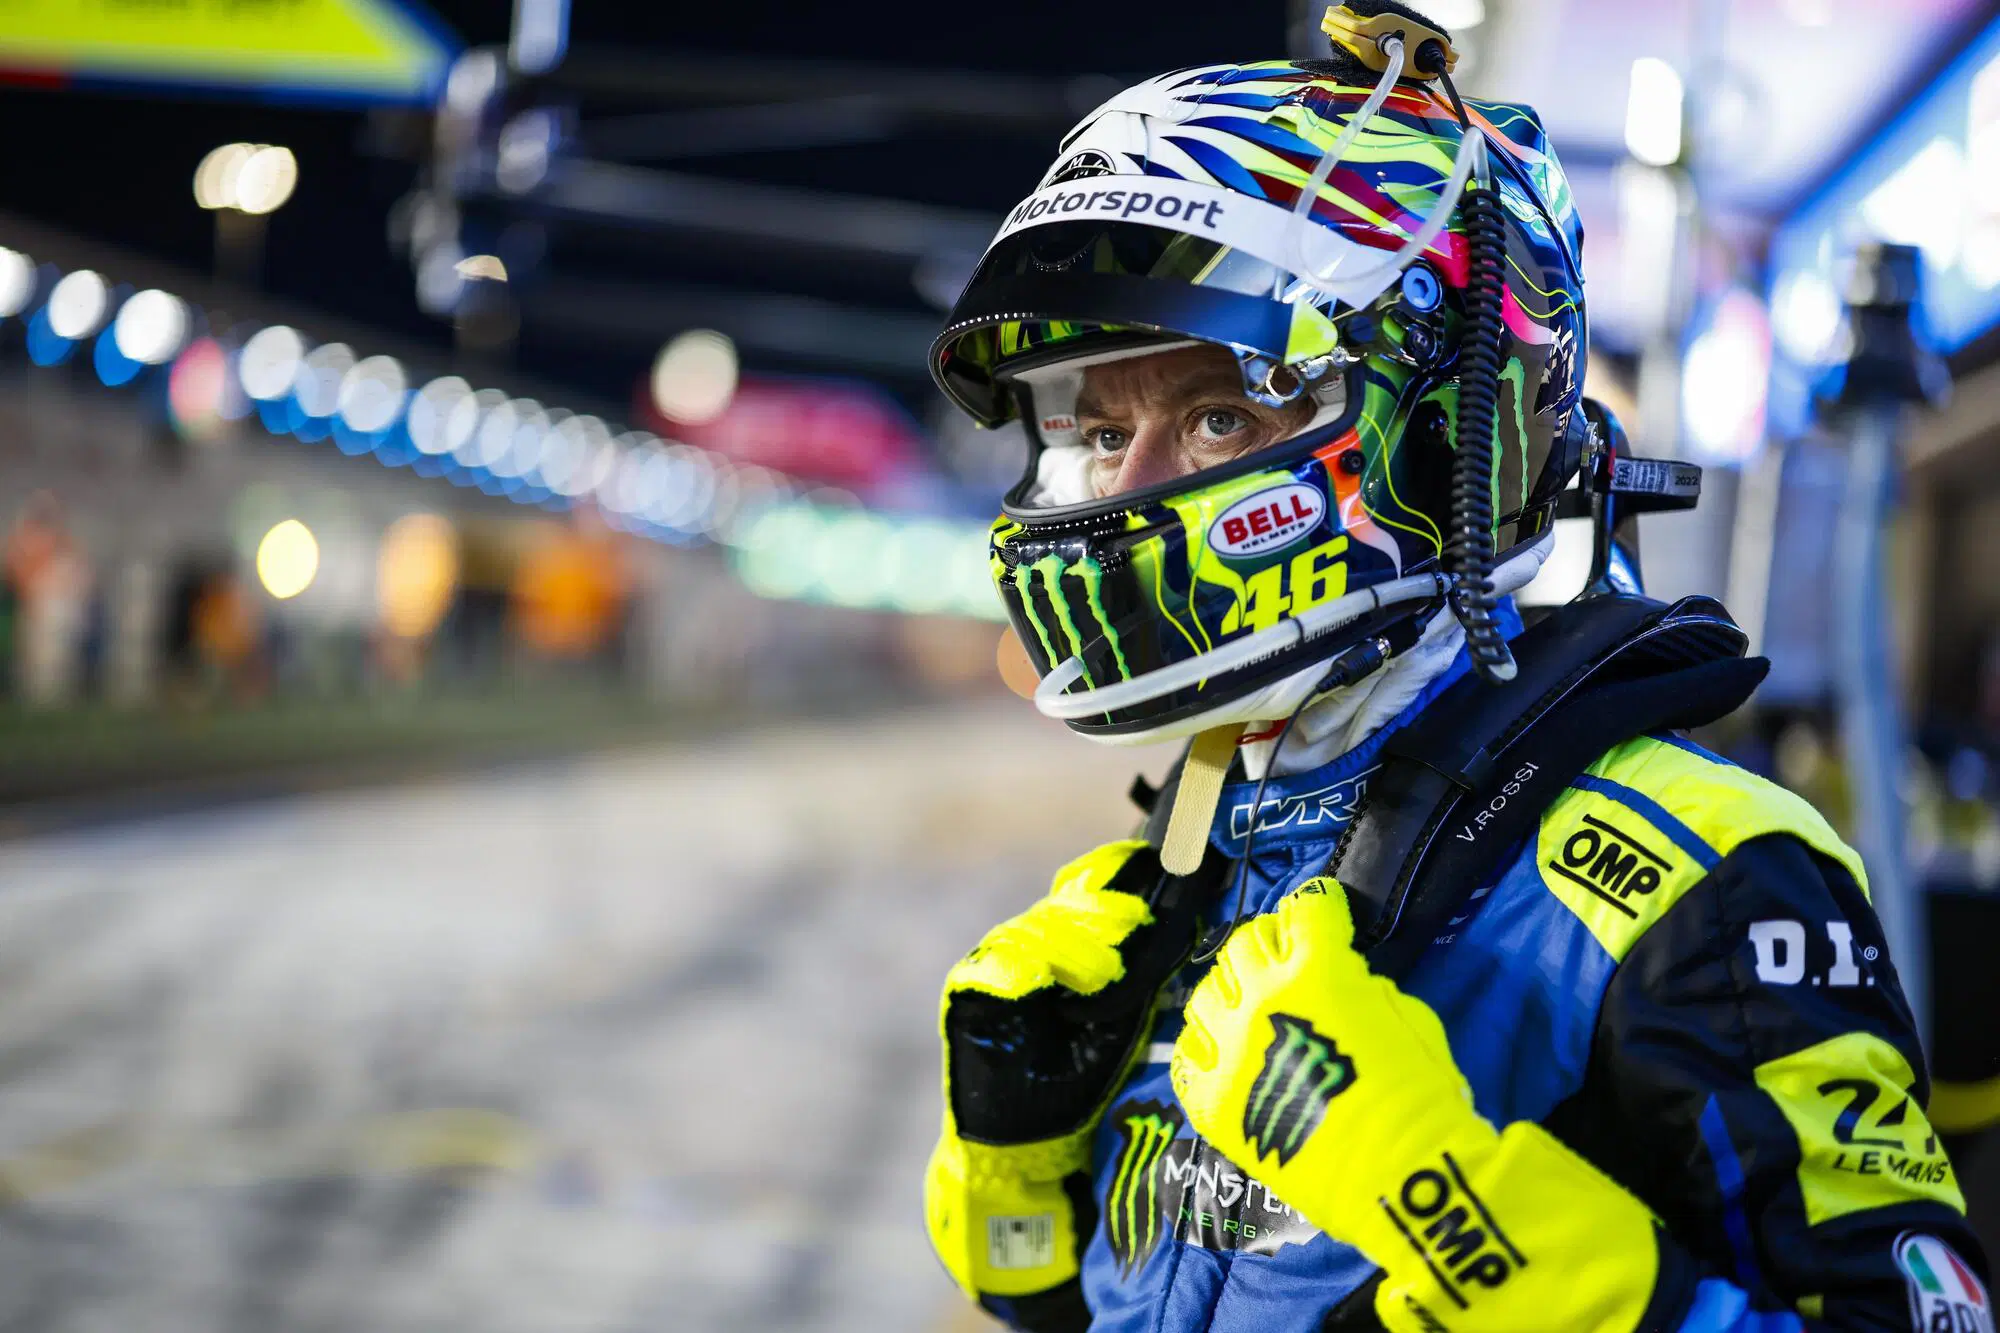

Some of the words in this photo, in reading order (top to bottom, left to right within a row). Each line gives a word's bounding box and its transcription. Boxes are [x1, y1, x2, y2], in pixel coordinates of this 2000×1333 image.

[1004, 191, 1225, 232] Motorsport
[1675, 475, 1698, 487] 2022
[1223, 494, 1313, 545] BELL
[1241, 521, 1306, 550] HELMETS
[1221, 535, 1348, 636] 46
[1457, 762, 1539, 843] V.ROSSI
[1563, 829, 1660, 899] OMP
[1180, 1206, 1275, 1240] NERGY
[1401, 1169, 1509, 1288] OMP
